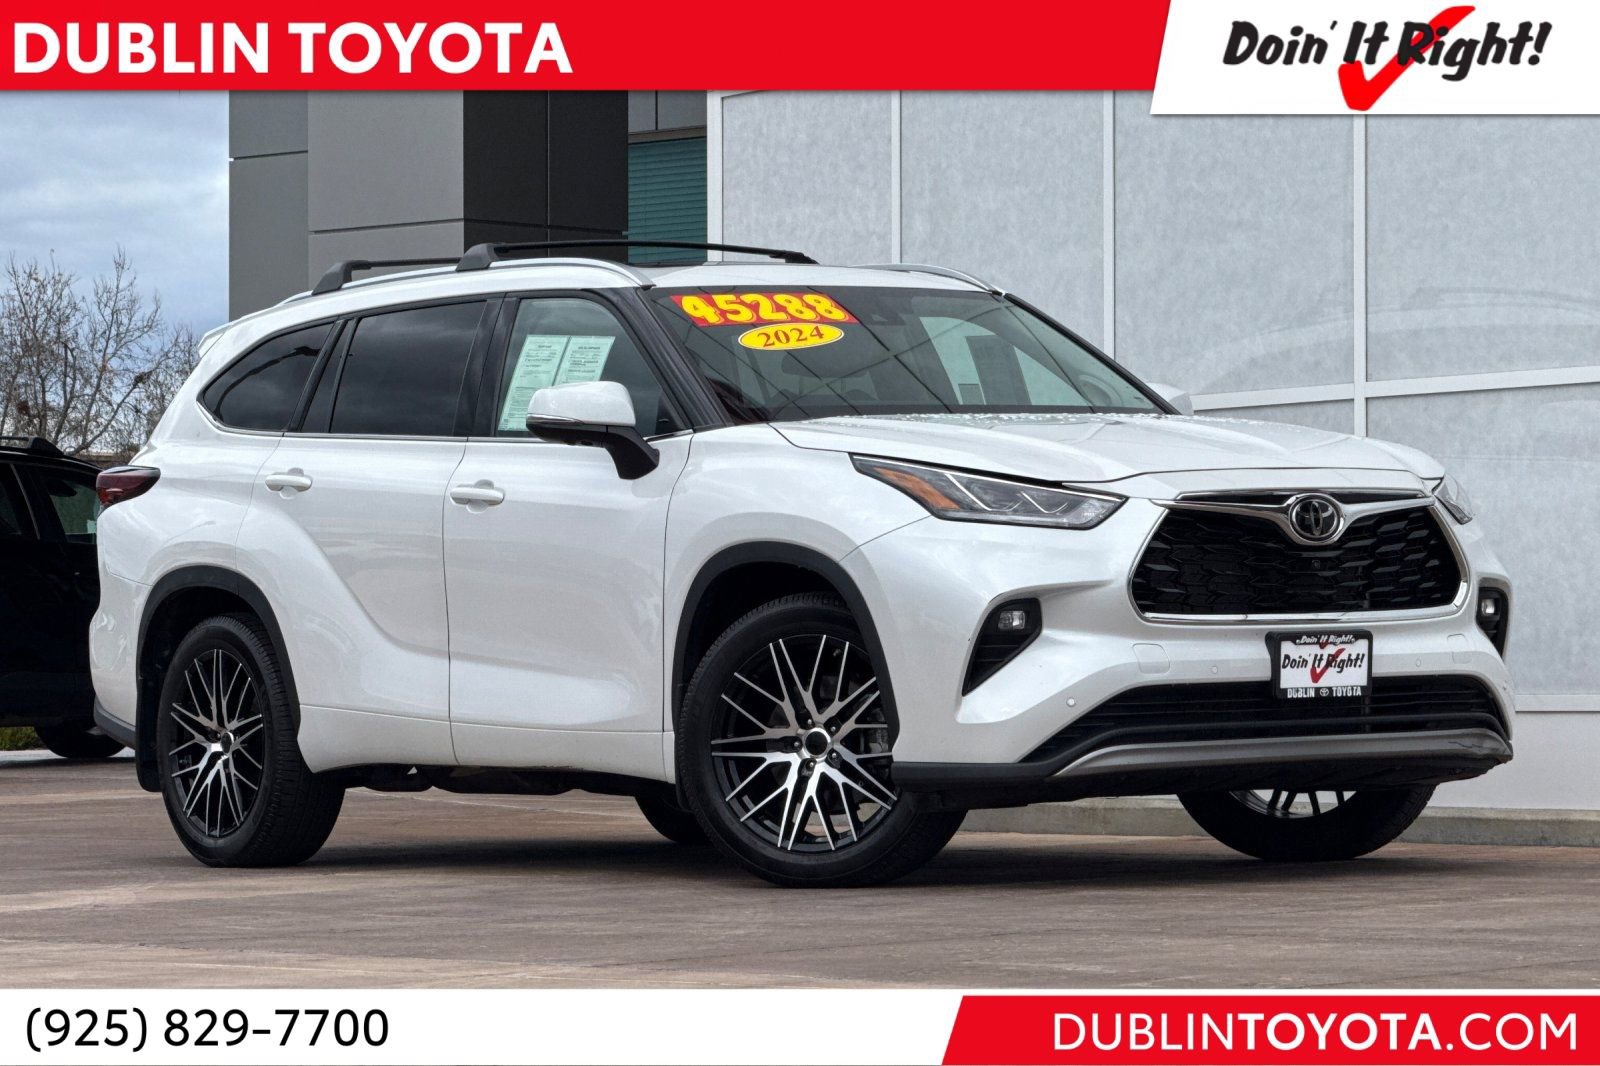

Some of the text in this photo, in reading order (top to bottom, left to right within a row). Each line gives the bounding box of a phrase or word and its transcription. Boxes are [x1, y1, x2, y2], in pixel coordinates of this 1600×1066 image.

[681, 293, 849, 324] 45288
[757, 325, 825, 348] 2024
[1281, 653, 1365, 673] Doin' It Right!
[1287, 686, 1362, 698] DUBLIN TOYOTA
